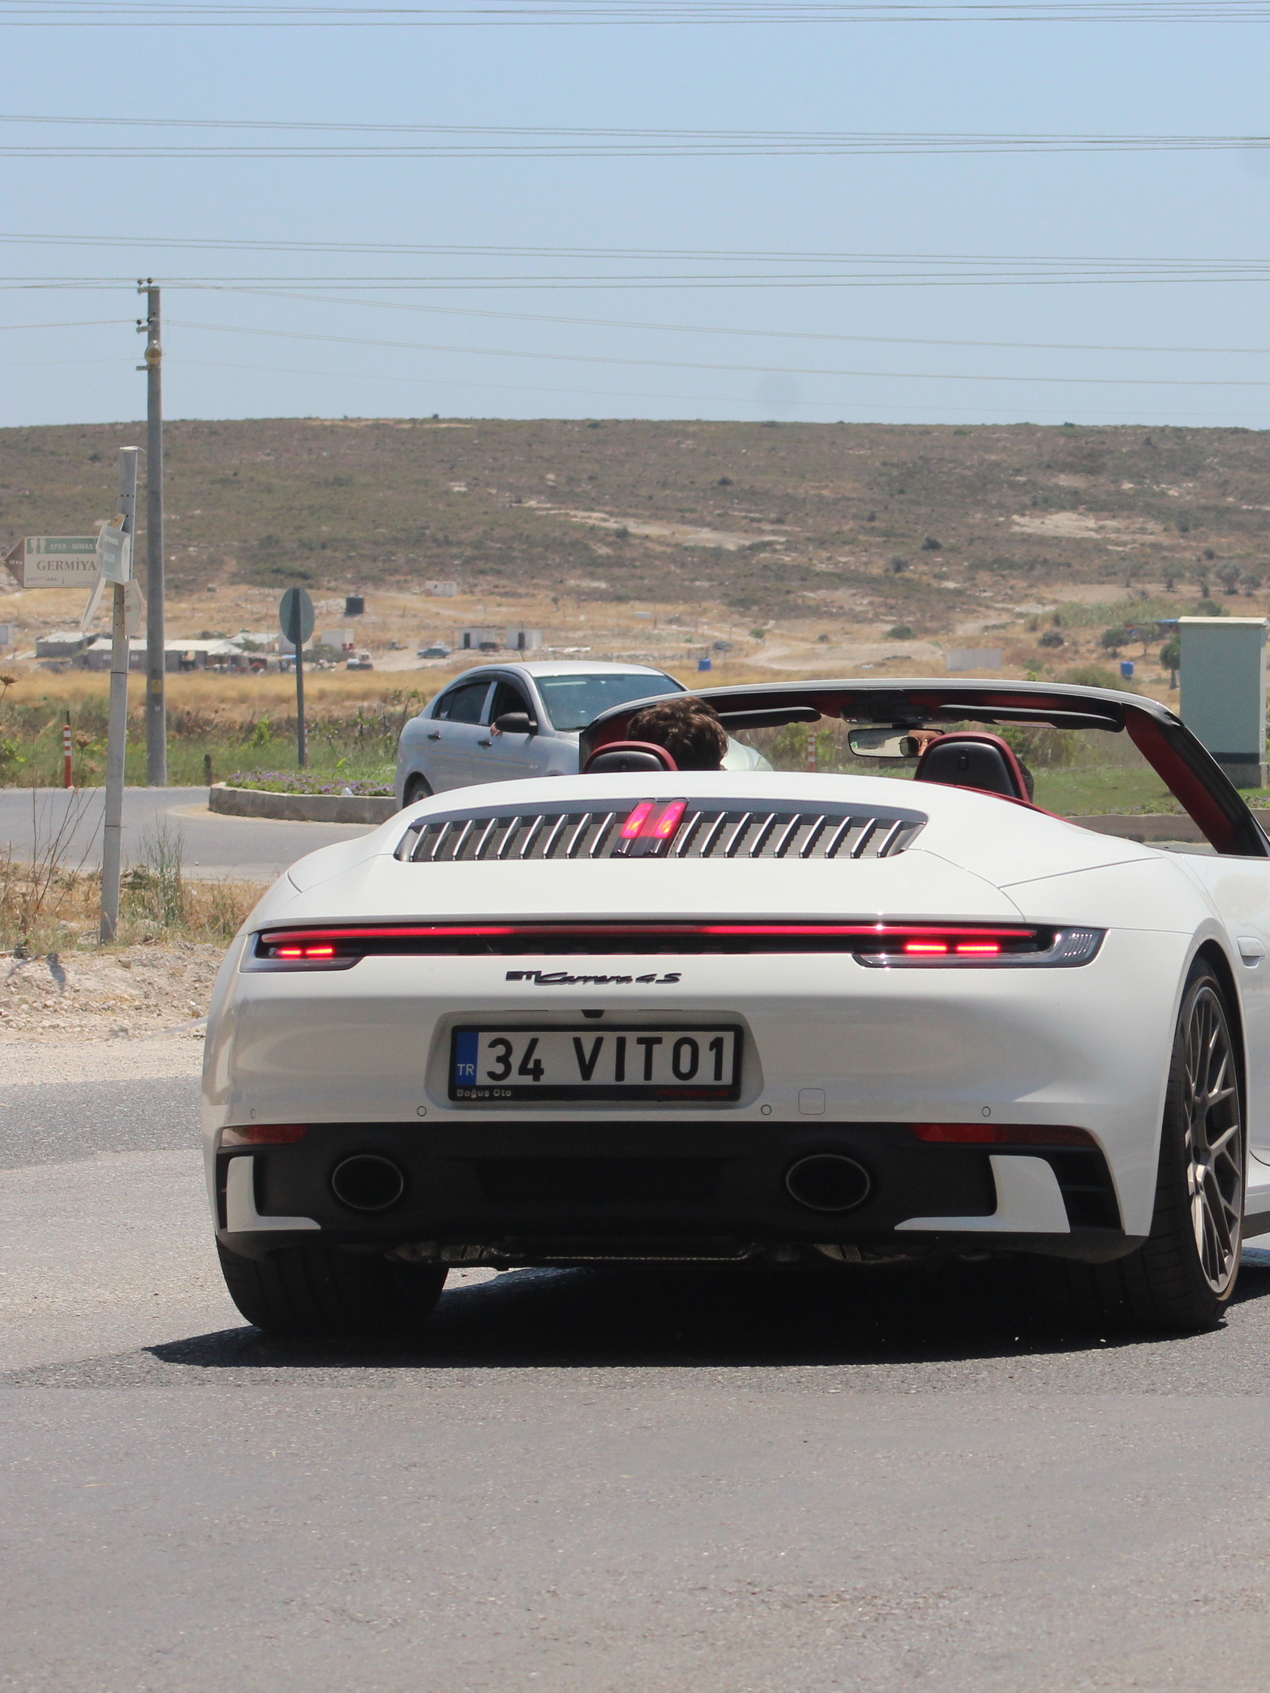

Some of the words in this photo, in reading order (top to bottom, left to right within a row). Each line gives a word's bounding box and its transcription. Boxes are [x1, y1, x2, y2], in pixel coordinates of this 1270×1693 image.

[36, 557, 98, 571] GERMİYA
[535, 971, 633, 986] Carrera
[486, 1037, 545, 1082] 34
[457, 1063, 475, 1076] TR
[492, 1088, 512, 1098] Oto
